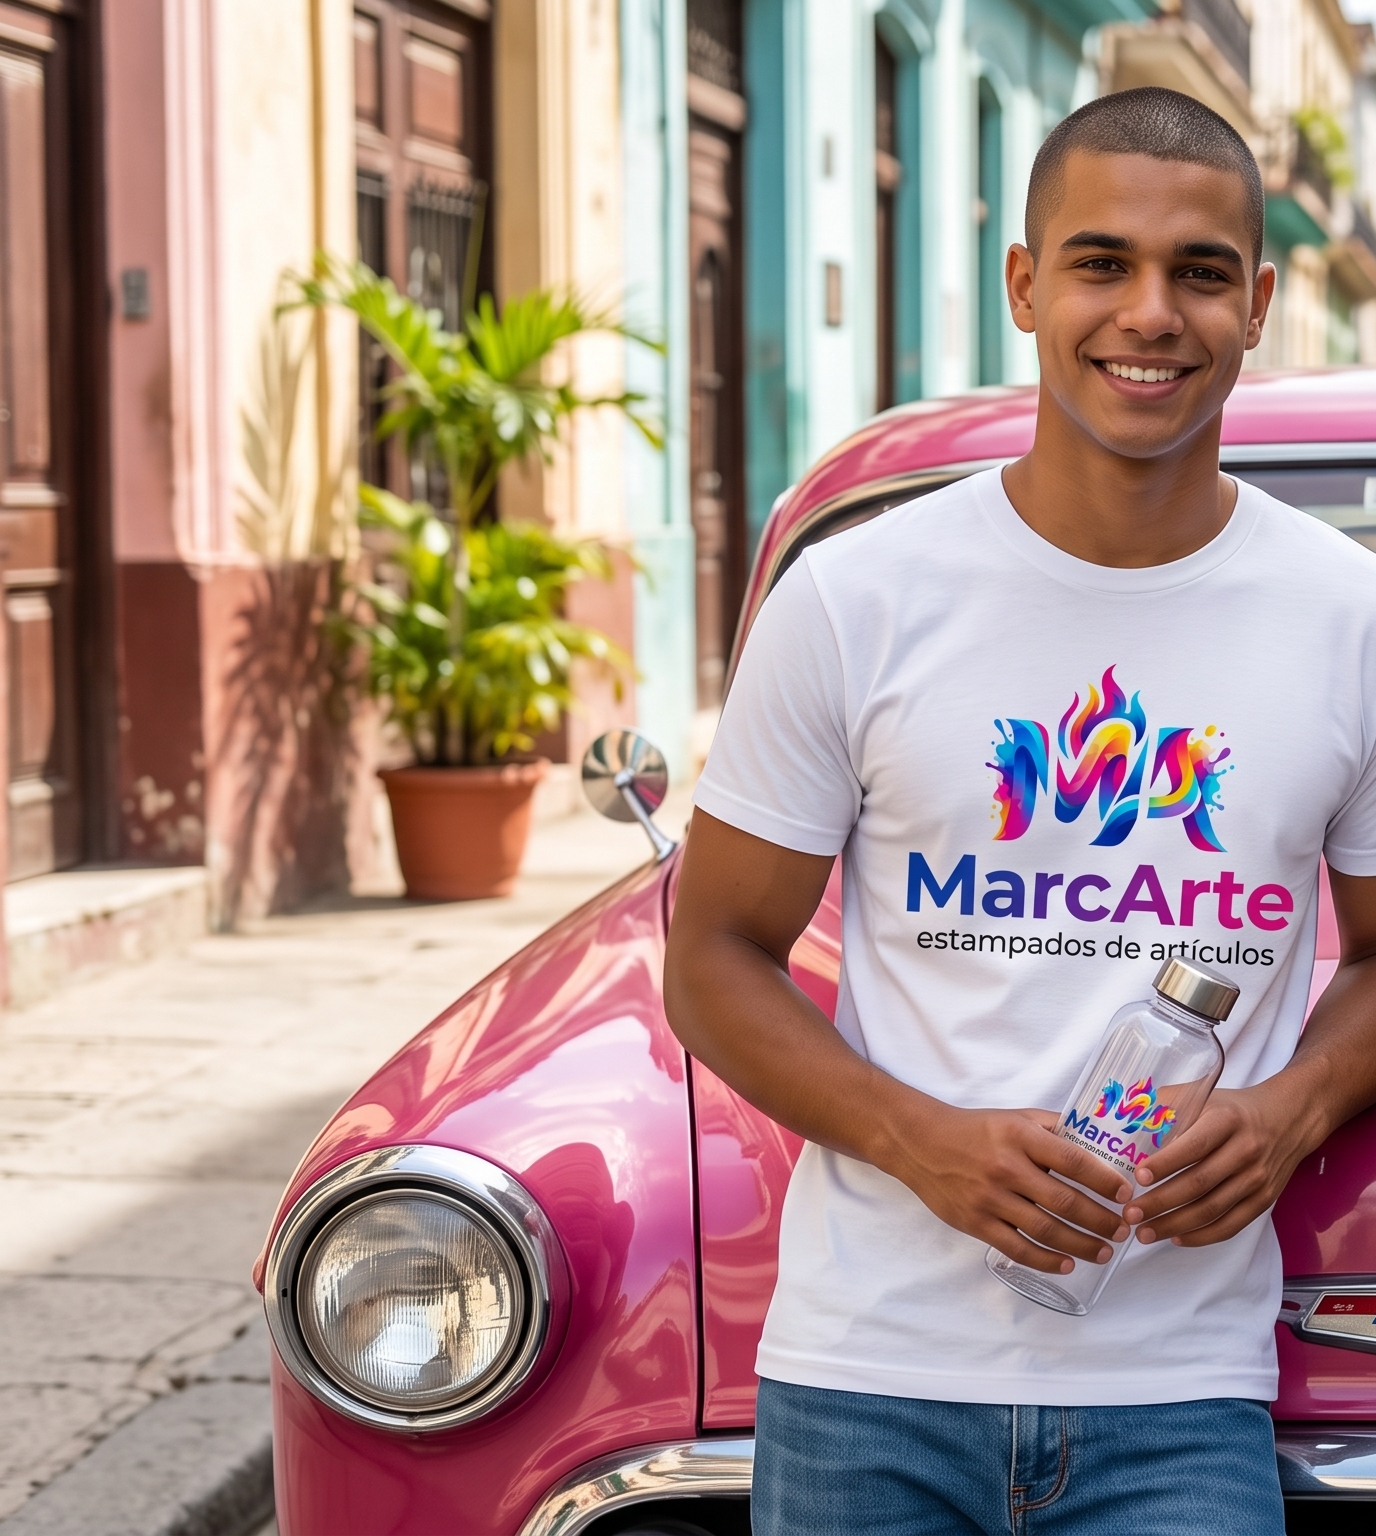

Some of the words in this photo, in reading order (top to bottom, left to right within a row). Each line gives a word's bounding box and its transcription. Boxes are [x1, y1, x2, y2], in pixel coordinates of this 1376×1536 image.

[906, 851, 1294, 931] MarcArte
[916, 928, 1097, 959] estampados
[1104, 934, 1141, 960] de
[1150, 939, 1274, 966] artículos
